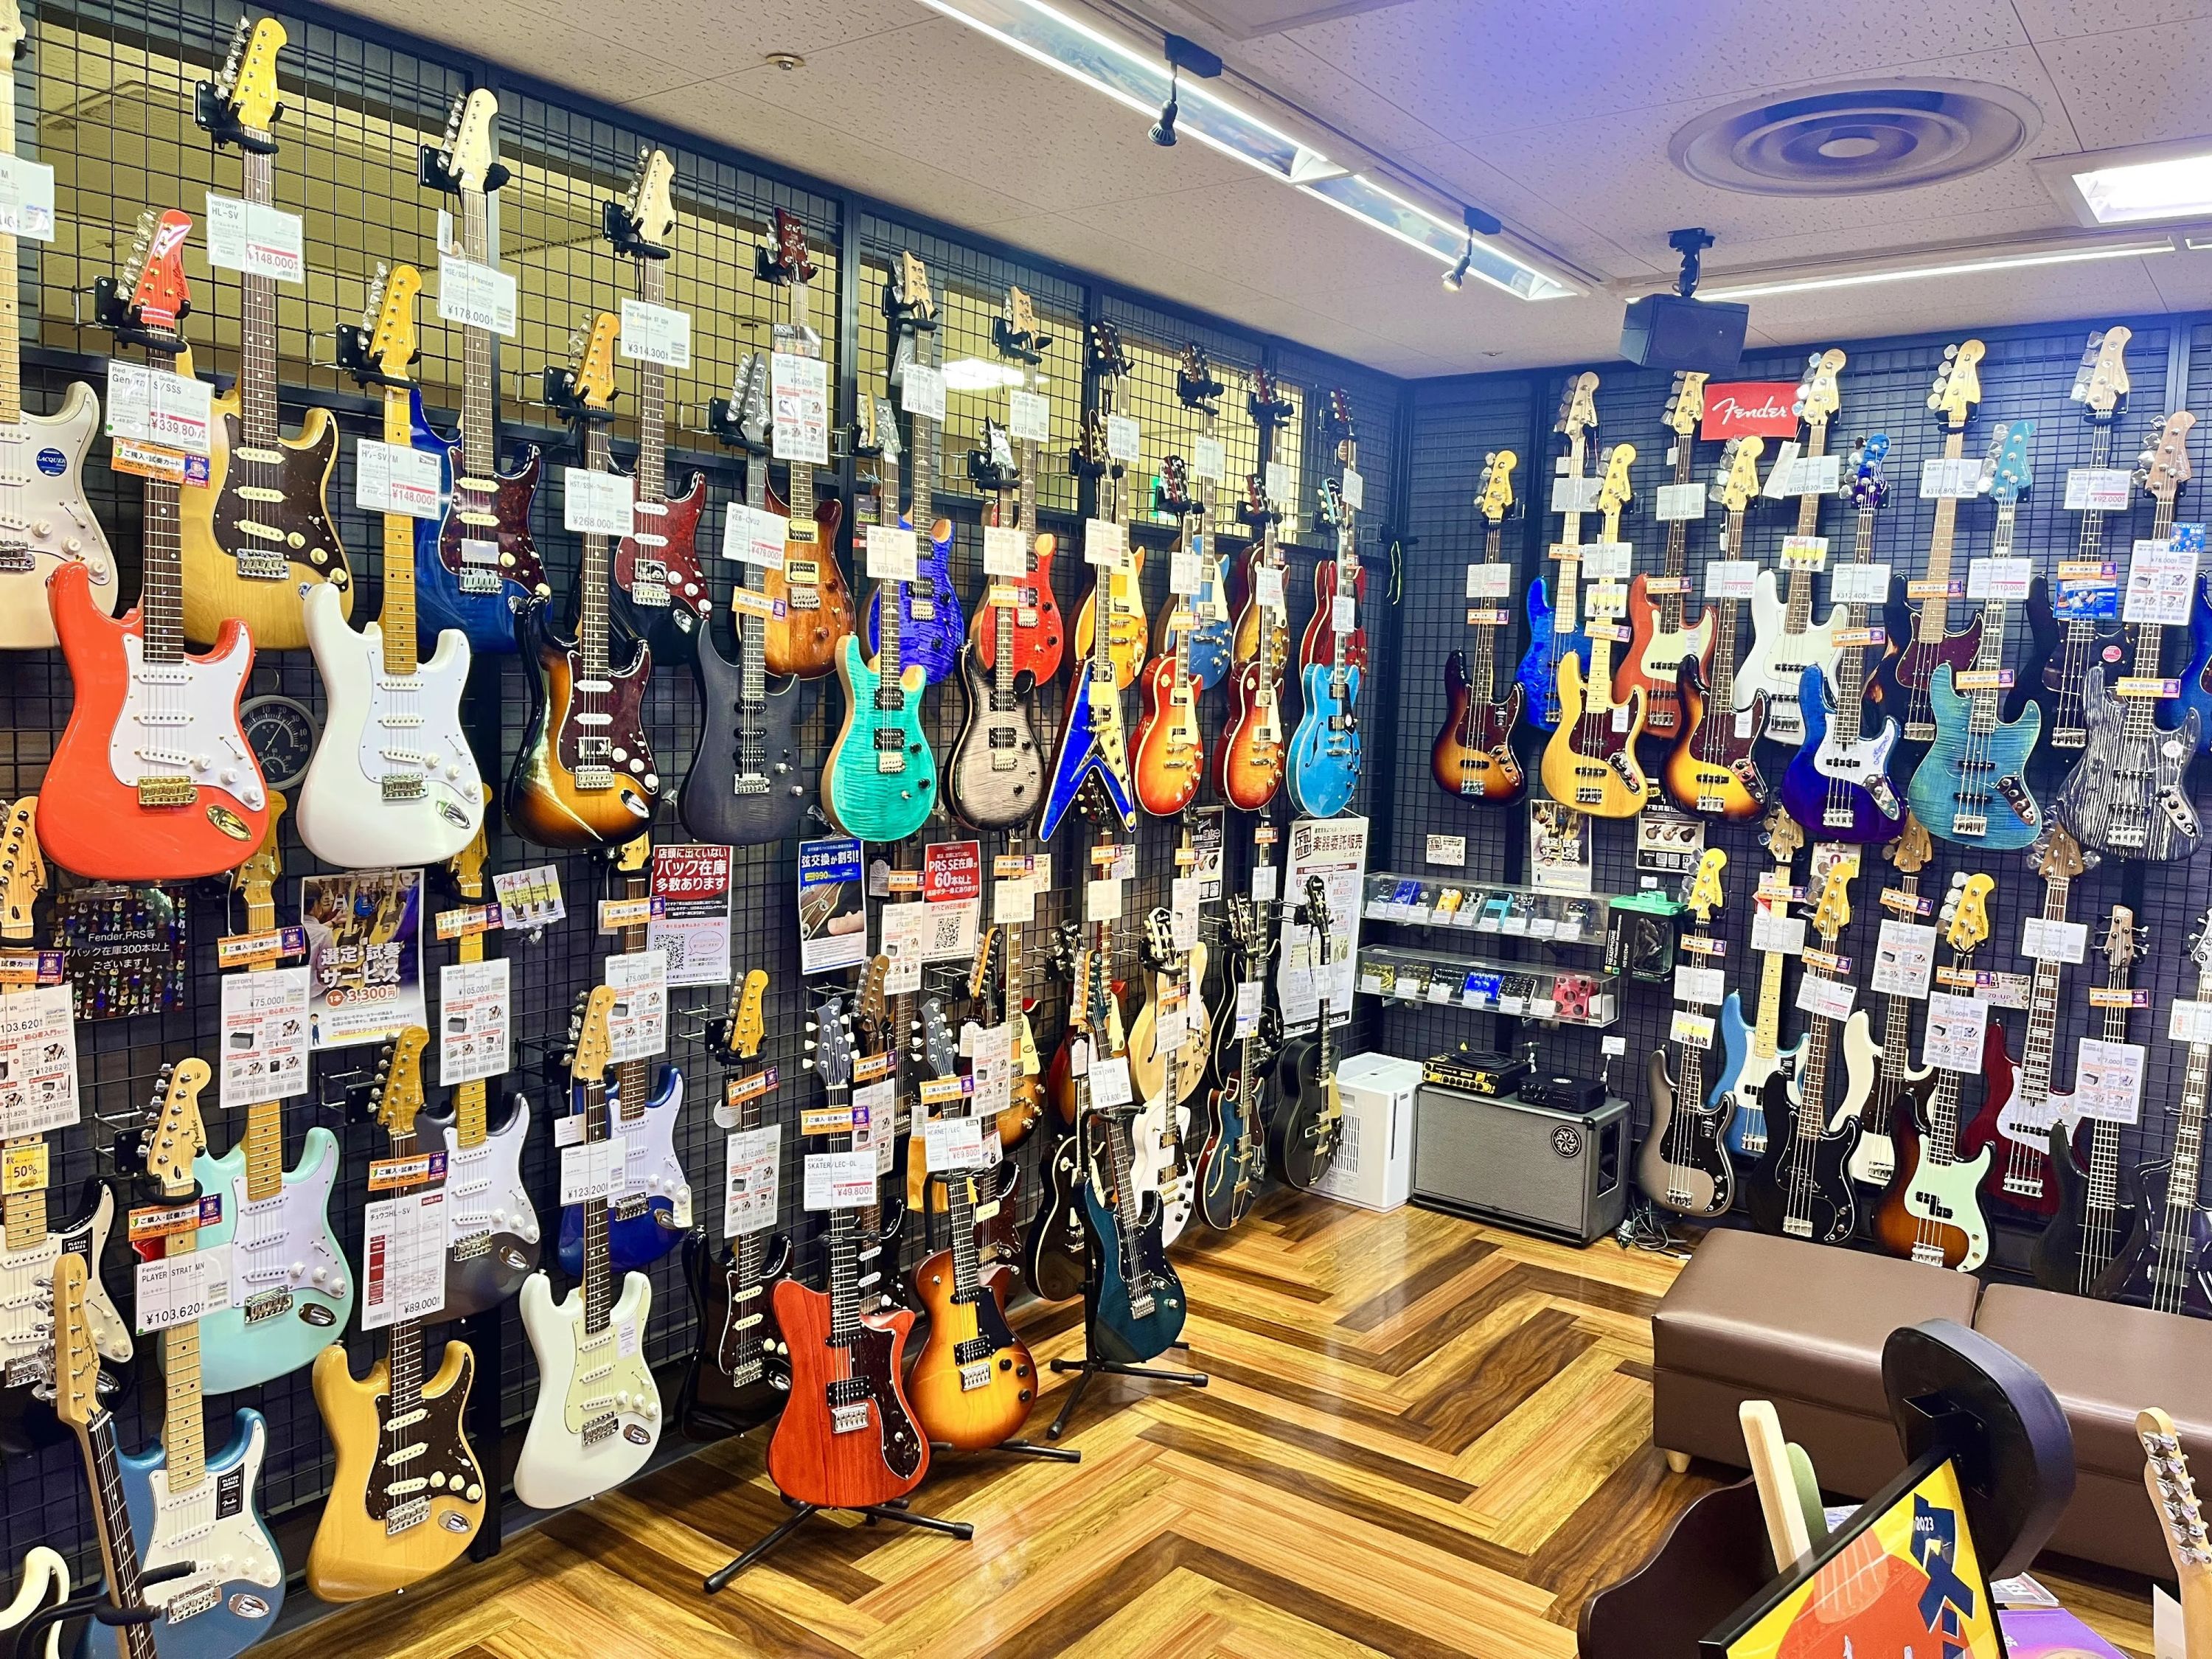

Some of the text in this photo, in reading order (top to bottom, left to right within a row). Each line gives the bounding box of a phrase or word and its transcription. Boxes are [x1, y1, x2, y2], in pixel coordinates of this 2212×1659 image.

[212, 207, 238, 219] HL-SV
[1712, 396, 1787, 425] Fender
[37, 456, 66, 465] LACQUER
[1313, 834, 1363, 852] 楽器委託販売
[658, 848, 728, 860] 店頭に出ていない
[656, 859, 728, 877] バック在庫
[929, 860, 947, 872] PRS
[655, 877, 726, 893] 多数あります
[934, 872, 972, 888] 60本以上
[88, 929, 156, 942] Fender,PRS等
[71, 942, 170, 957] バック在庫300本以上
[321, 942, 401, 965] 選定・試奏
[321, 961, 401, 988] サービス
[141, 1208, 196, 1225] ご購入・試奏カード
[142, 1265, 164, 1273] Fender
[142, 1262, 205, 1283] PLAYER STRAT MN
[223, 1475, 239, 1484] PLAYER
[1915, 1516, 1934, 1531] 2023
